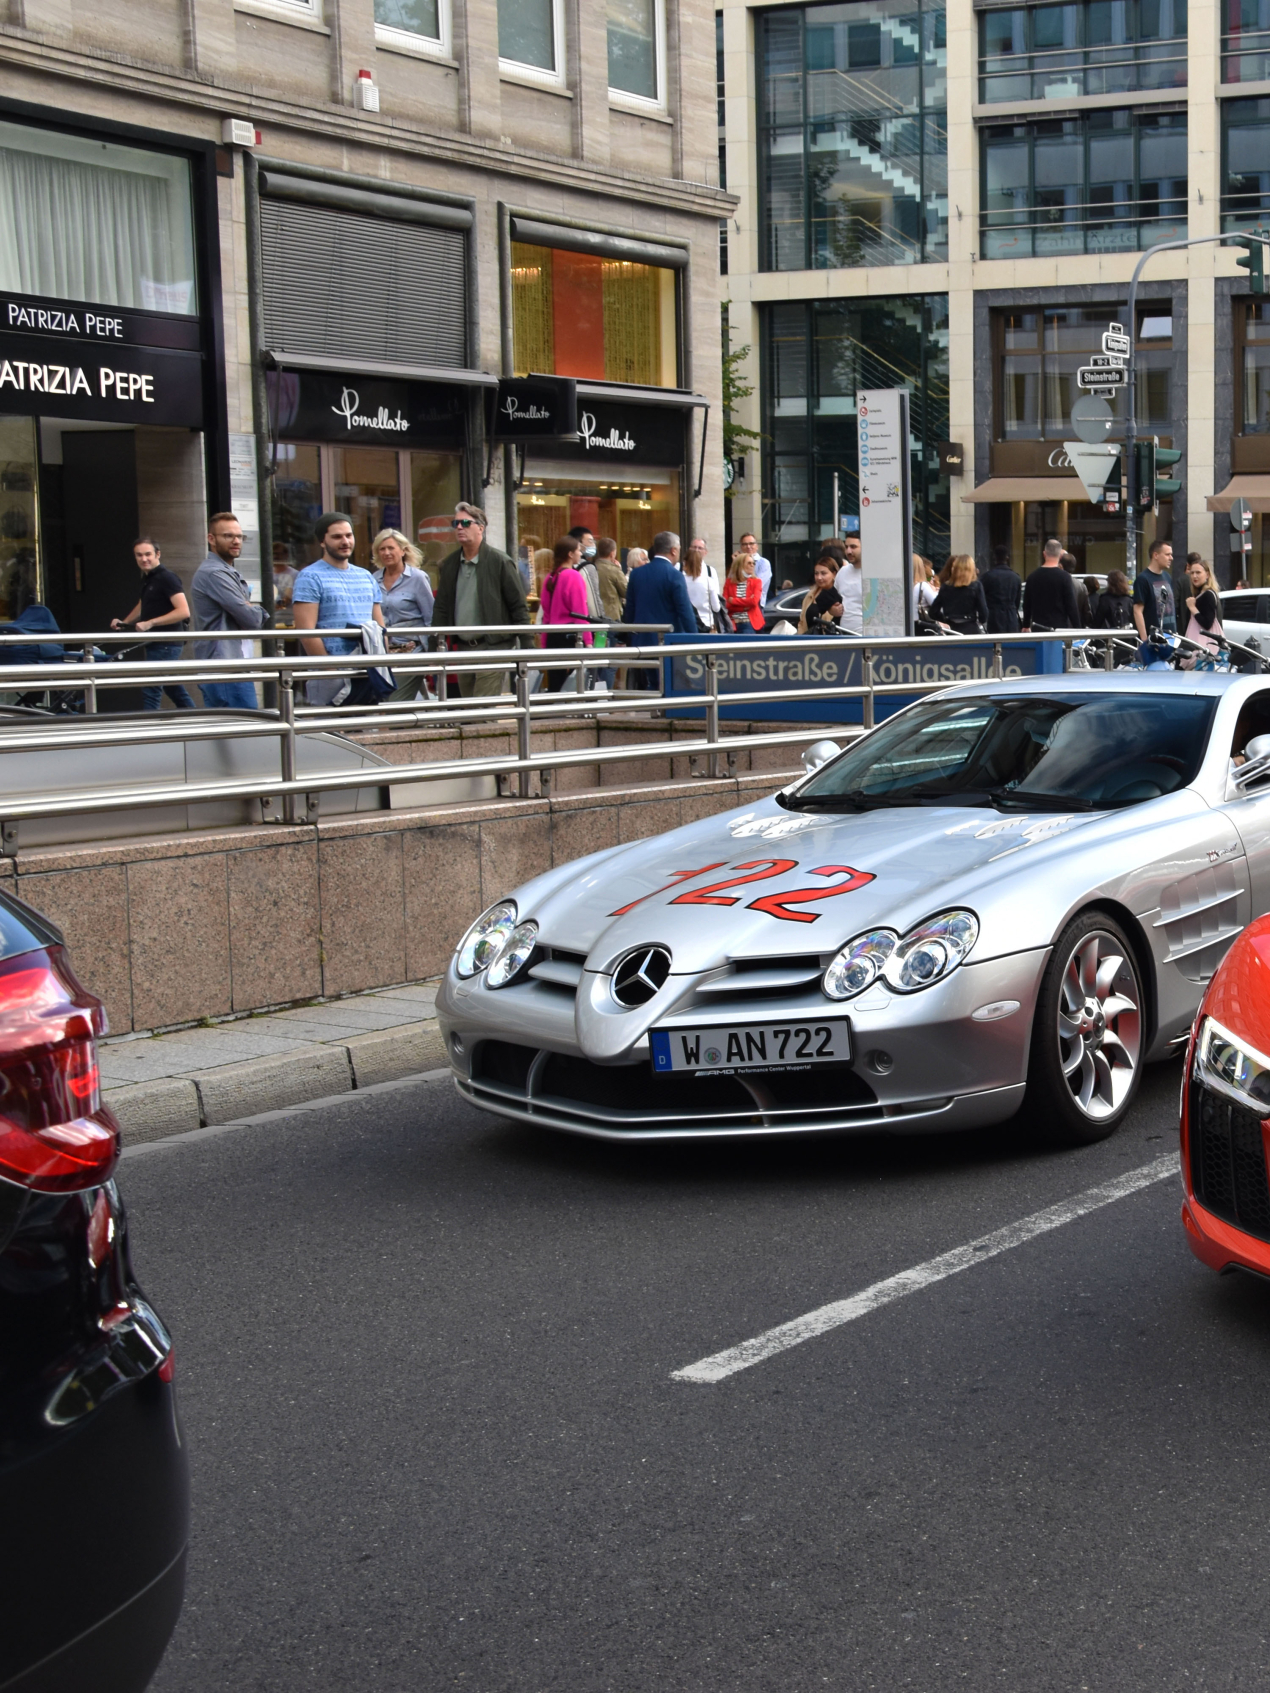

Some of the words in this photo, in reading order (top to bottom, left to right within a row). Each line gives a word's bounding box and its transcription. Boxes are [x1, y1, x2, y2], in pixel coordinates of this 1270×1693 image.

[8, 303, 80, 333] PATRIZIA
[85, 313, 124, 338] PEPE
[0, 360, 92, 397] ATRIZIA
[100, 367, 155, 402] PEPE
[1083, 372, 1120, 382] Steinstraße
[331, 386, 410, 431] Pomellato
[501, 396, 550, 421] Pomellato
[577, 411, 636, 450] Pomellato
[606, 859, 877, 923] 722
[659, 1056, 666, 1065] D
[681, 1034, 700, 1066] W
[773, 1026, 835, 1060] 722
[708, 1068, 735, 1076] AMG
[786, 1064, 812, 1072] Wuppertal
